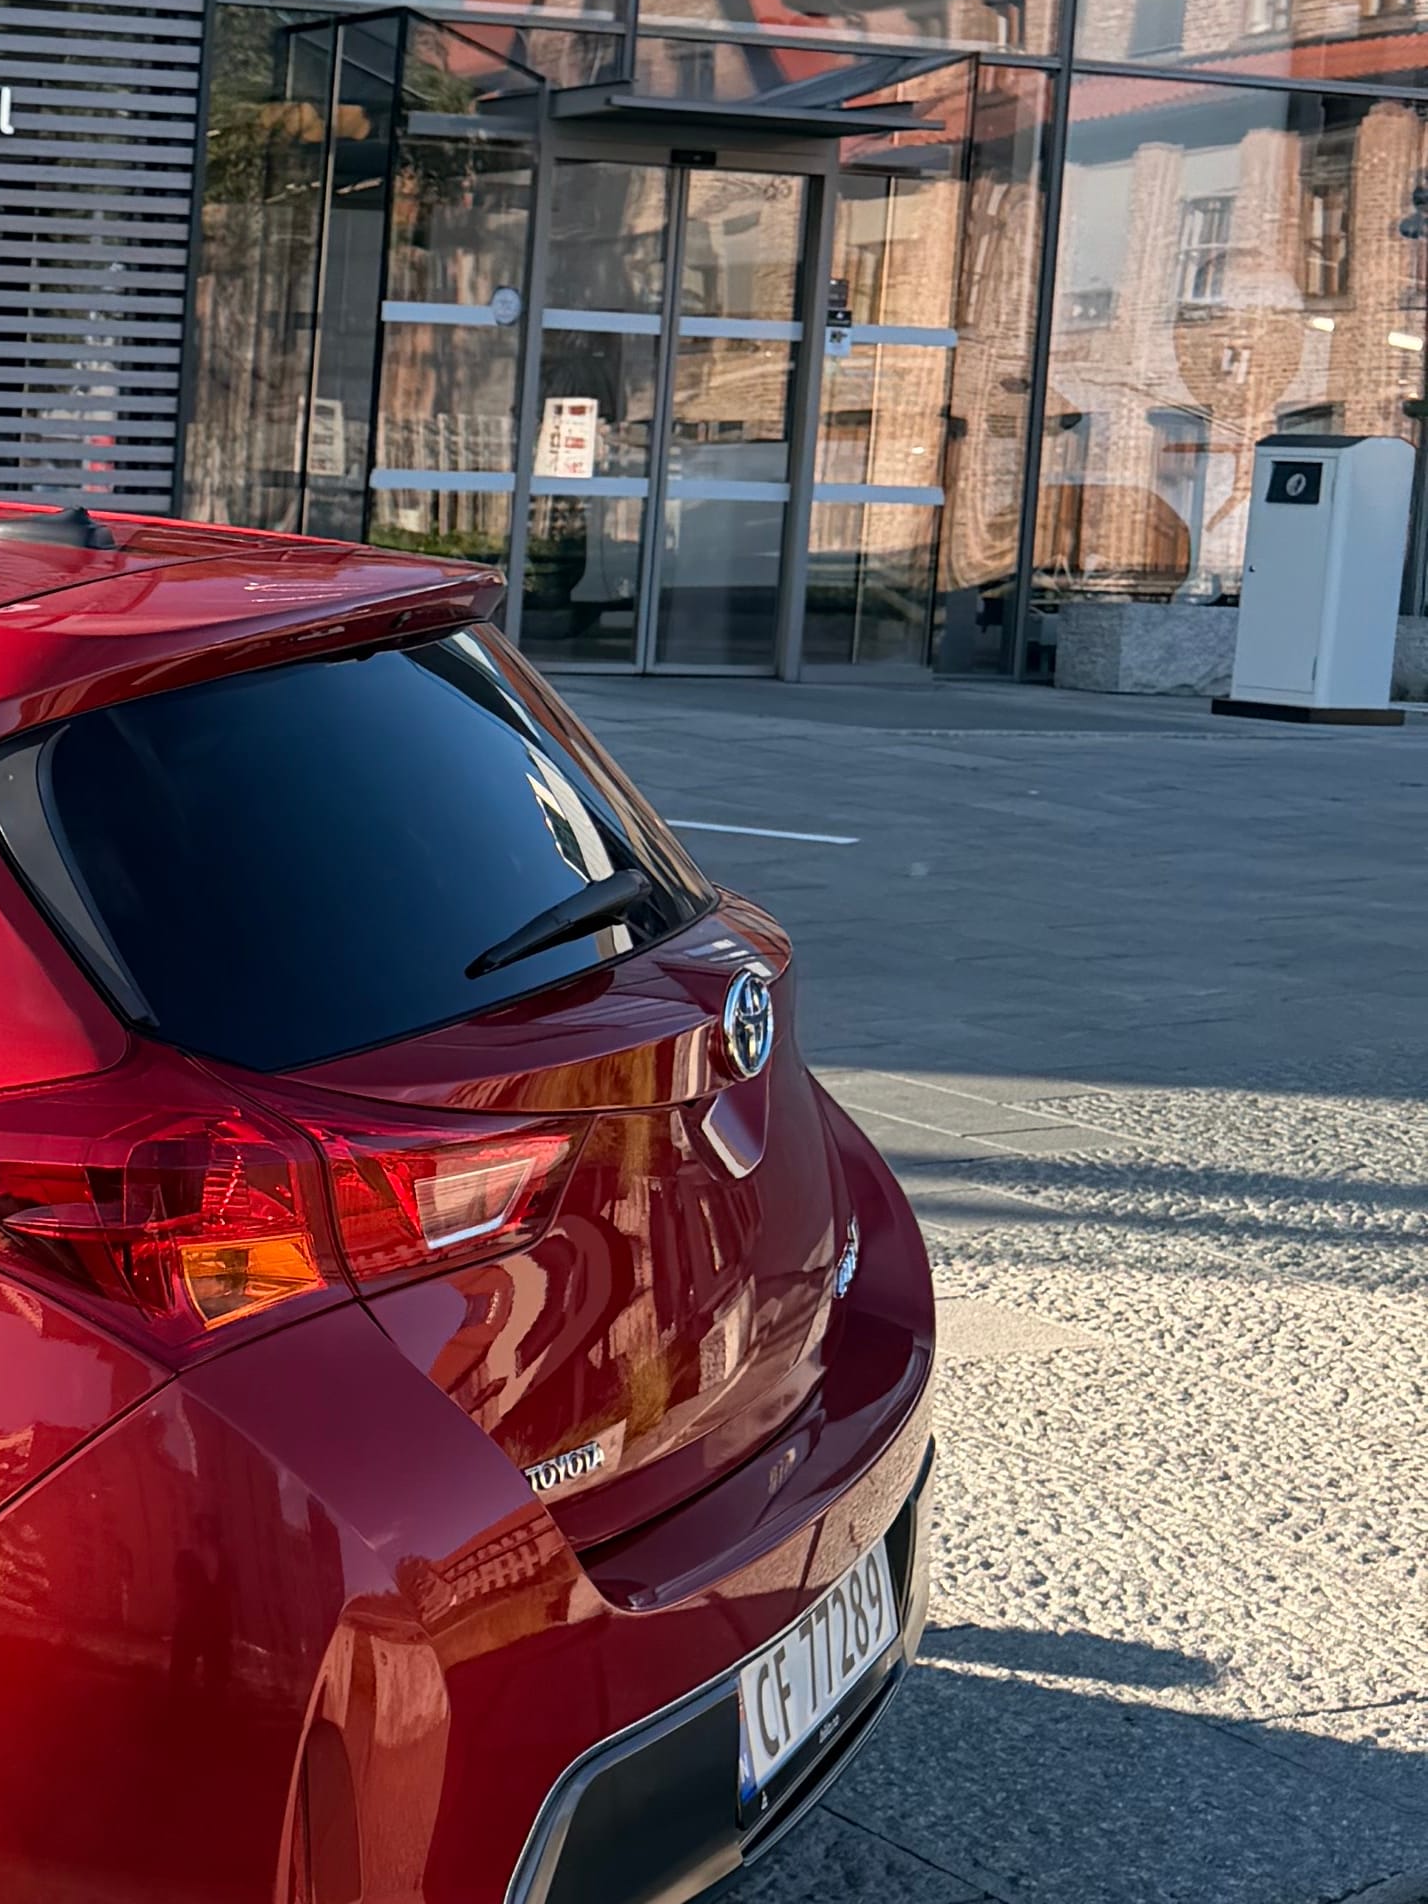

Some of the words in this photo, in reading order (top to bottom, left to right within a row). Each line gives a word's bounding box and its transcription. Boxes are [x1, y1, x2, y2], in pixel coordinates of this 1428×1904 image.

[522, 1440, 606, 1493] TOYOTA
[756, 1643, 793, 1759] CF
[798, 1552, 884, 1713] 77289
